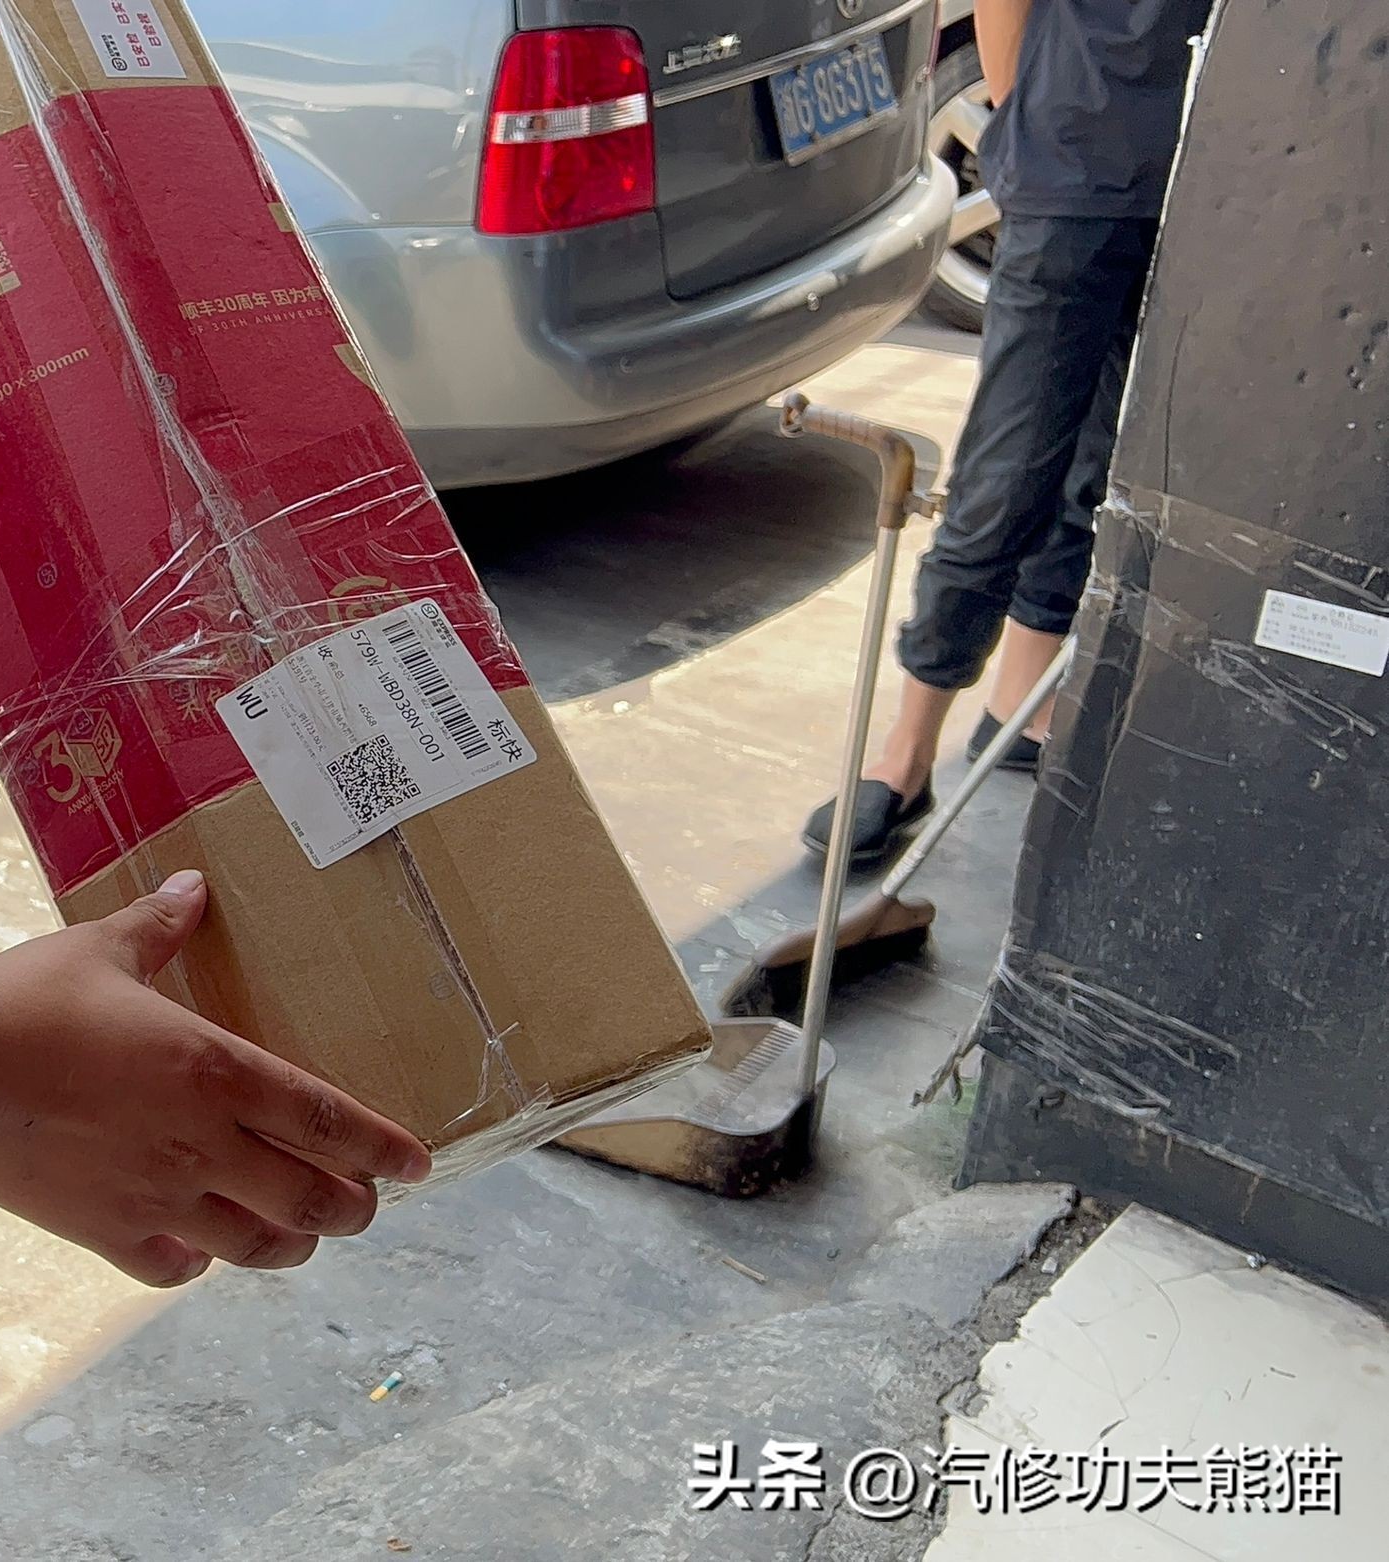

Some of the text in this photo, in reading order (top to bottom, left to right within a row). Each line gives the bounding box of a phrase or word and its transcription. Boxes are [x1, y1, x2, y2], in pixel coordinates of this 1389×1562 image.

[111, 0, 130, 24] 已实
[178, 291, 271, 320] 顺丰30周年
[27, 347, 90, 383] 300mm
[437, 618, 457, 646] EXPRESS
[318, 645, 333, 661] 收
[236, 685, 269, 720] WU
[351, 629, 445, 762] 579W-WBD38N-001
[487, 718, 523, 763] 标快
